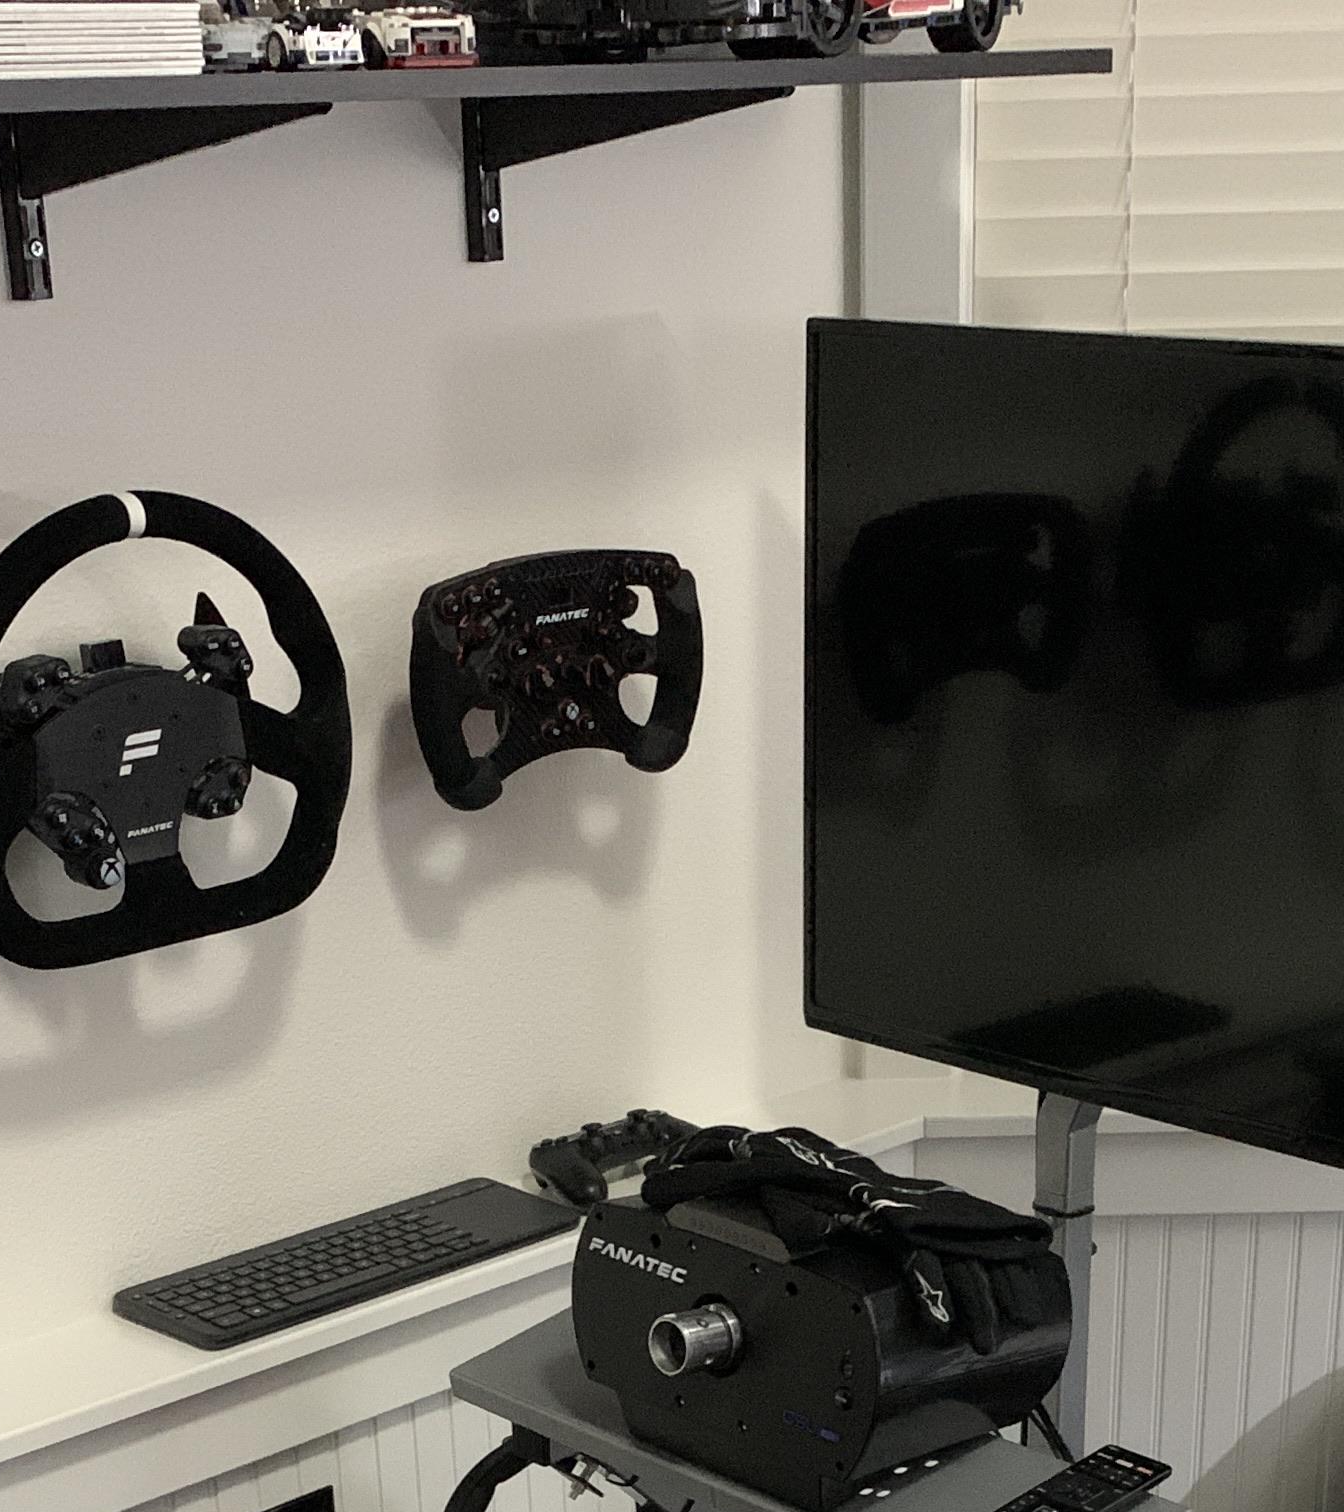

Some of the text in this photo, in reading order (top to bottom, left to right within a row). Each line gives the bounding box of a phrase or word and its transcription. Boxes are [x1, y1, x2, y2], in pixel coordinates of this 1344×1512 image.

[535, 607, 590, 627] FANATEC
[127, 820, 174, 839] FANATEC
[588, 1236, 688, 1285] FANATEC
